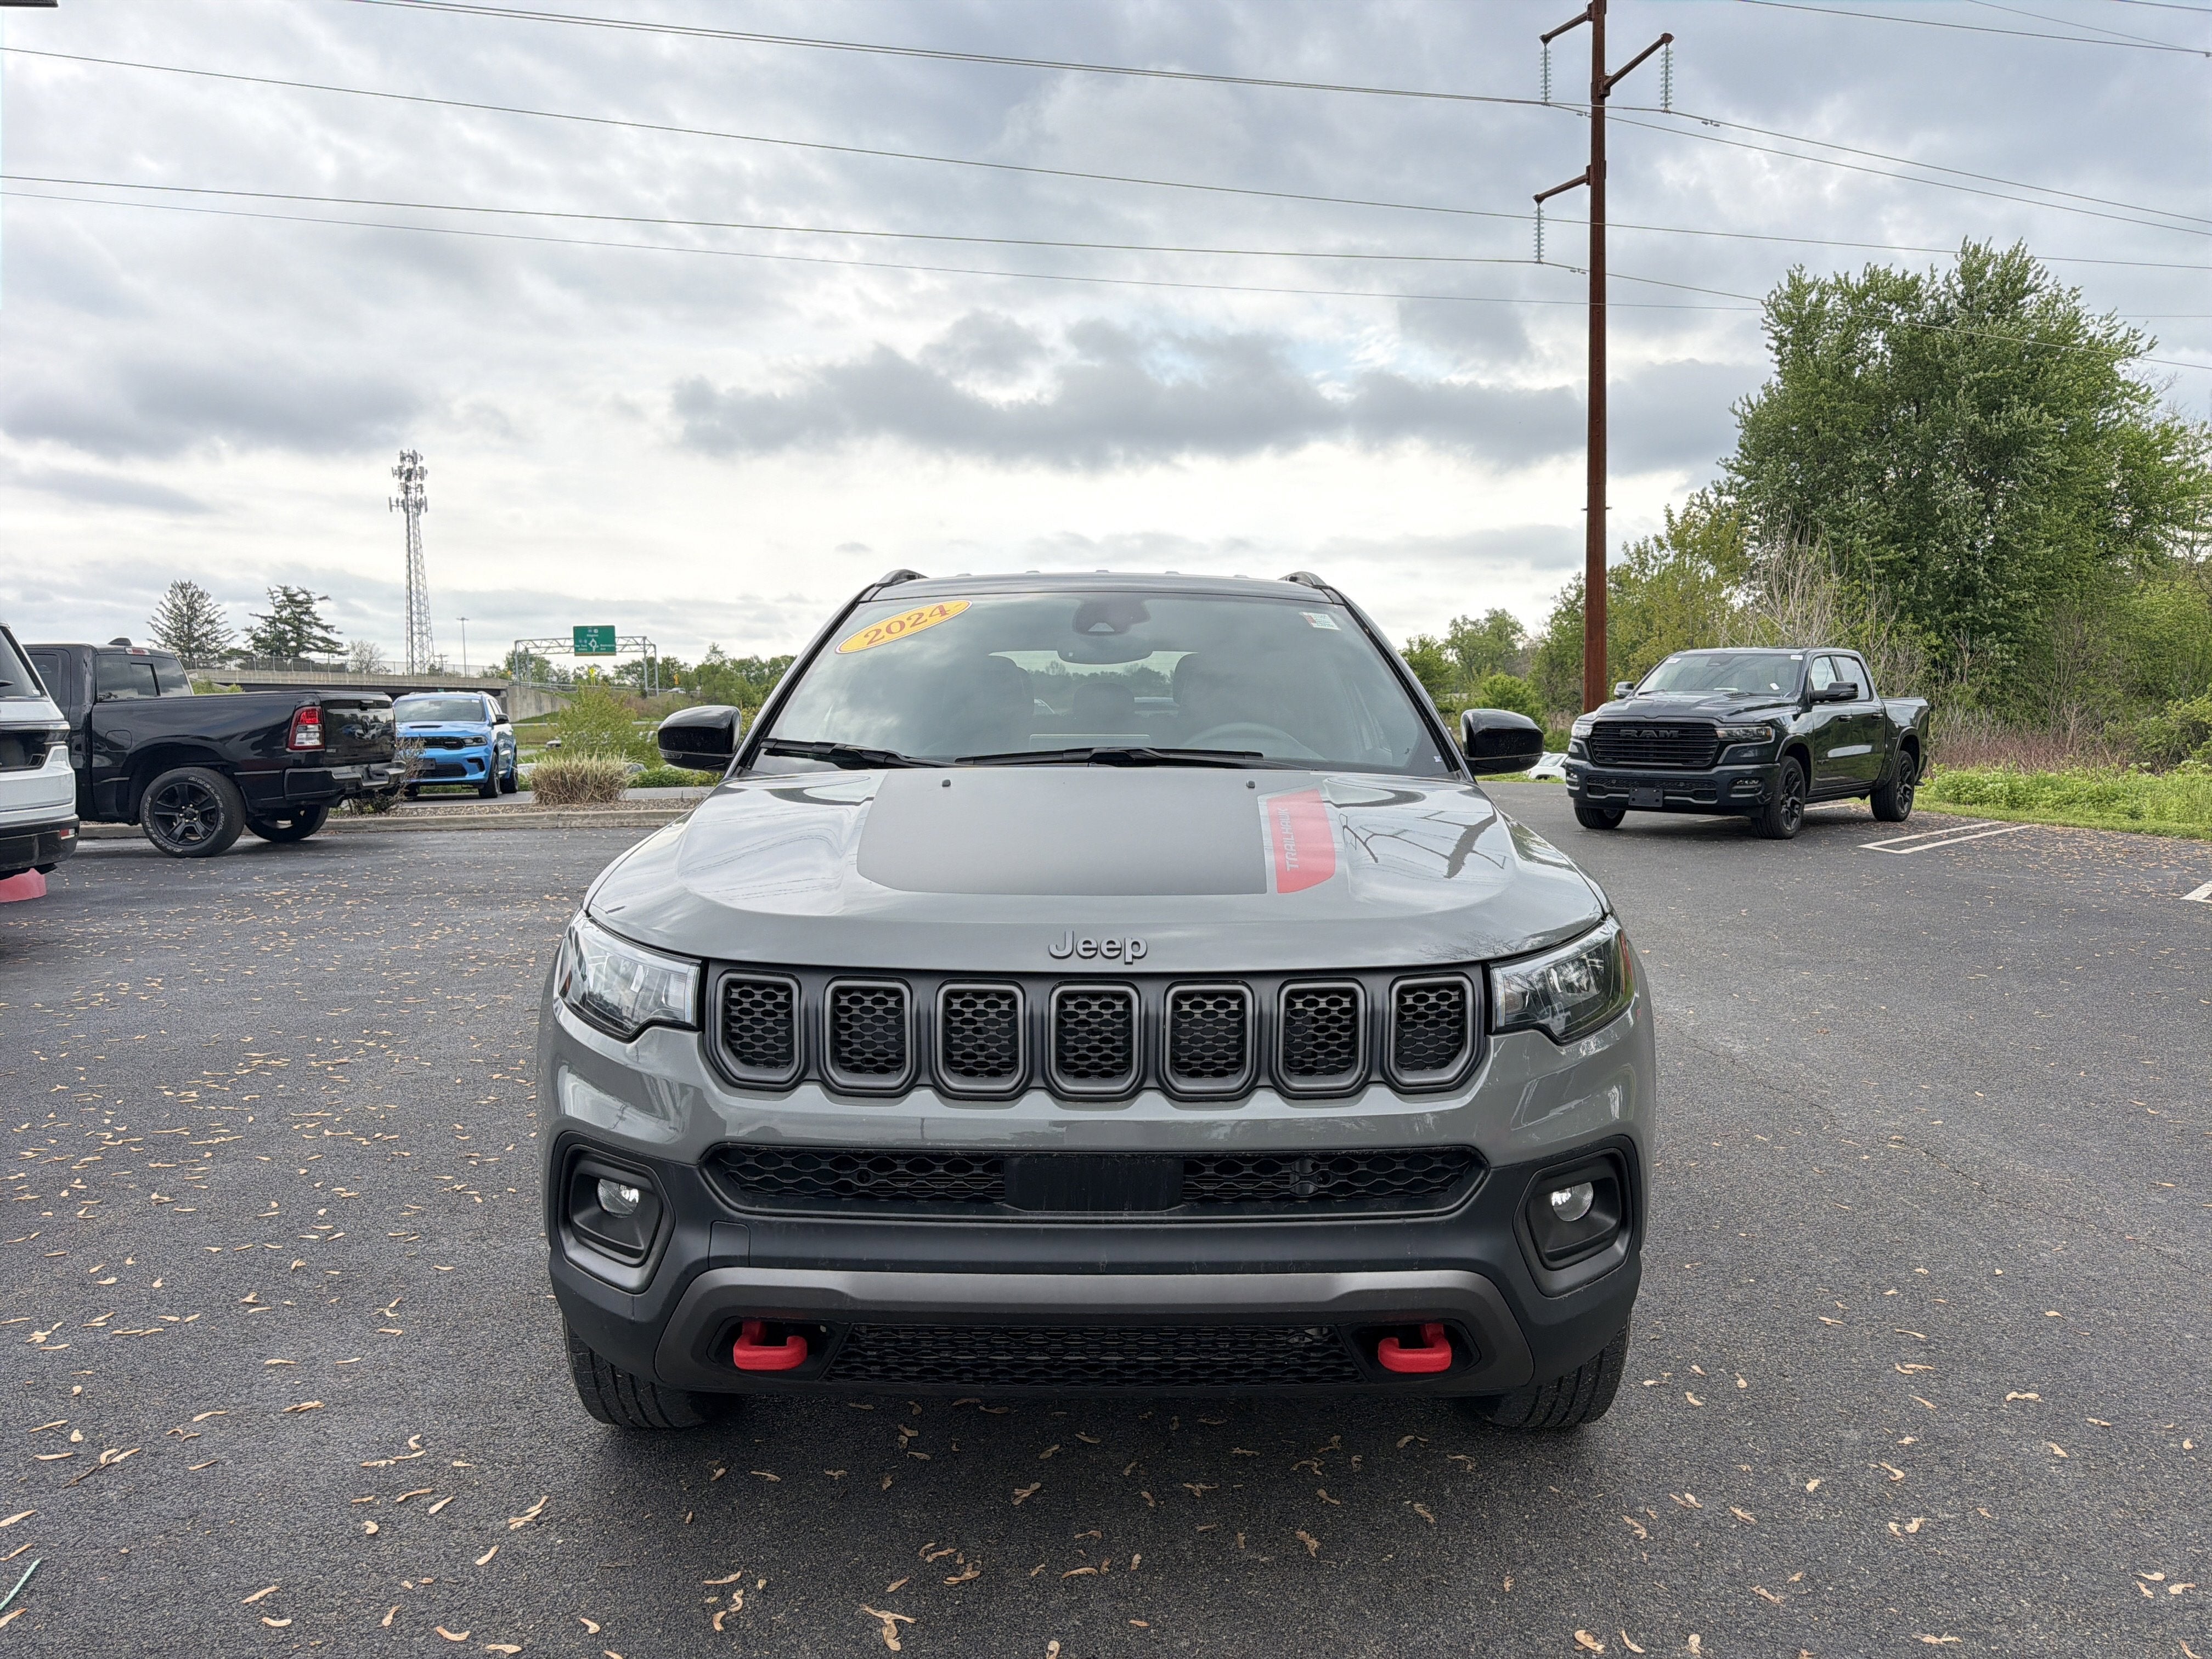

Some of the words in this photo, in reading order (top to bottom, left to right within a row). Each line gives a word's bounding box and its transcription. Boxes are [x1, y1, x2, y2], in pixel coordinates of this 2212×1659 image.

[864, 605, 950, 645] 2024
[1620, 729, 1679, 739] RAM
[1277, 807, 1299, 871] TRAILHAWK
[1048, 930, 1148, 965] Jeep
